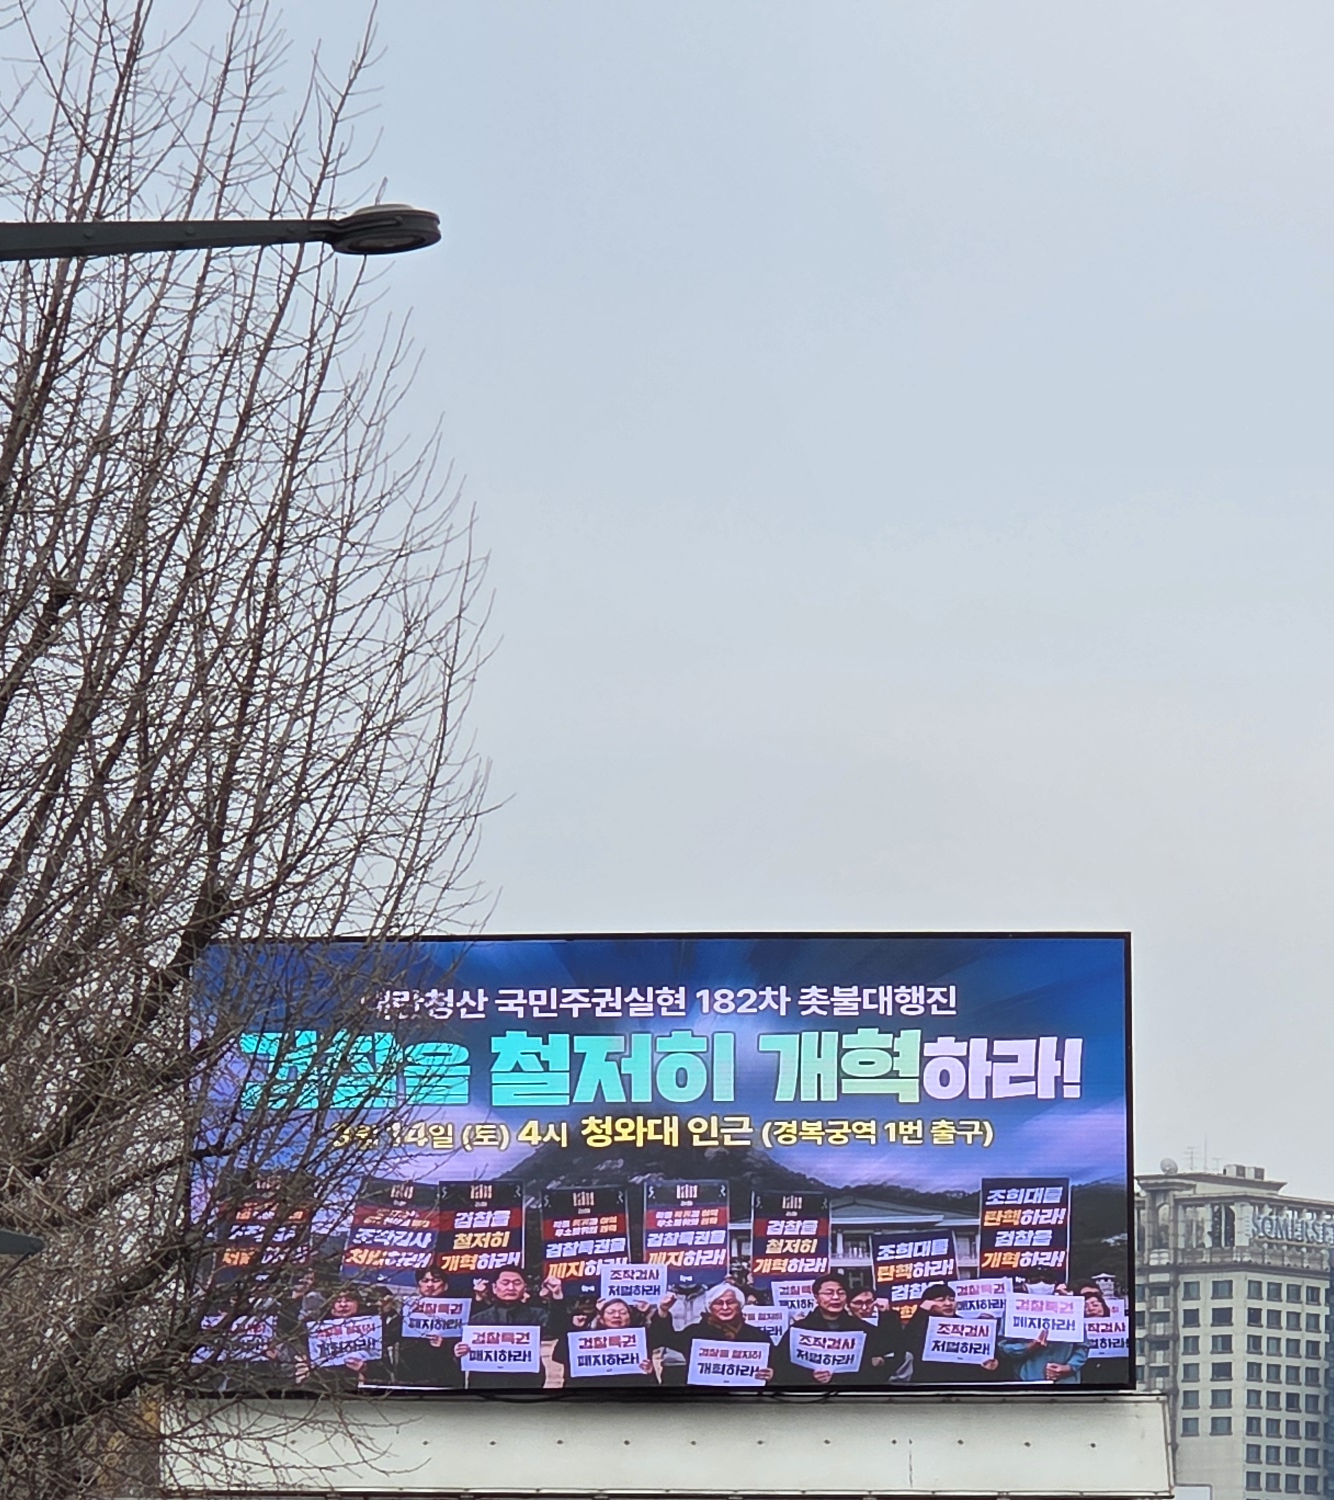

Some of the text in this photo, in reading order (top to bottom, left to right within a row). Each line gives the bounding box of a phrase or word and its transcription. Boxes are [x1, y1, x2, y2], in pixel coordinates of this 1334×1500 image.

[494, 986, 687, 1018] 국민주권실현
[696, 986, 791, 1017] 182차
[798, 985, 957, 1017] 촛불대행진
[489, 1029, 736, 1106] 철저히
[758, 1027, 1083, 1103] 개혁하라!
[462, 1122, 510, 1151] (토)
[518, 1119, 568, 1148] 4시
[581, 1115, 679, 1148] 청와대
[687, 1115, 753, 1147] 인근
[762, 1119, 877, 1148] (경복궁역
[884, 1121, 924, 1146] 1번
[930, 1119, 995, 1148] 출구)
[986, 1186, 1064, 1206] 조희대를
[454, 1210, 510, 1229] 검찰을
[983, 1208, 1066, 1227] 탄핵하라!
[766, 1220, 818, 1236] 검찰을
[453, 1231, 510, 1249] 철저히
[647, 1230, 726, 1247] 검찰특권을
[766, 1239, 818, 1254] 철저히
[994, 1229, 1053, 1248] 검찰을
[546, 1238, 626, 1259] 검찰특권을
[876, 1238, 949, 1262] 조희대를
[440, 1252, 522, 1272] 개혁하라!
[753, 1257, 828, 1274] 개혁하라!
[981, 1250, 1066, 1268] 개혁하라!
[877, 1258, 954, 1283] 탄핵하라!
[936, 1322, 990, 1337] 조작검사
[1087, 1322, 1126, 1334] 작검사
[799, 1334, 855, 1350] 조작검사
